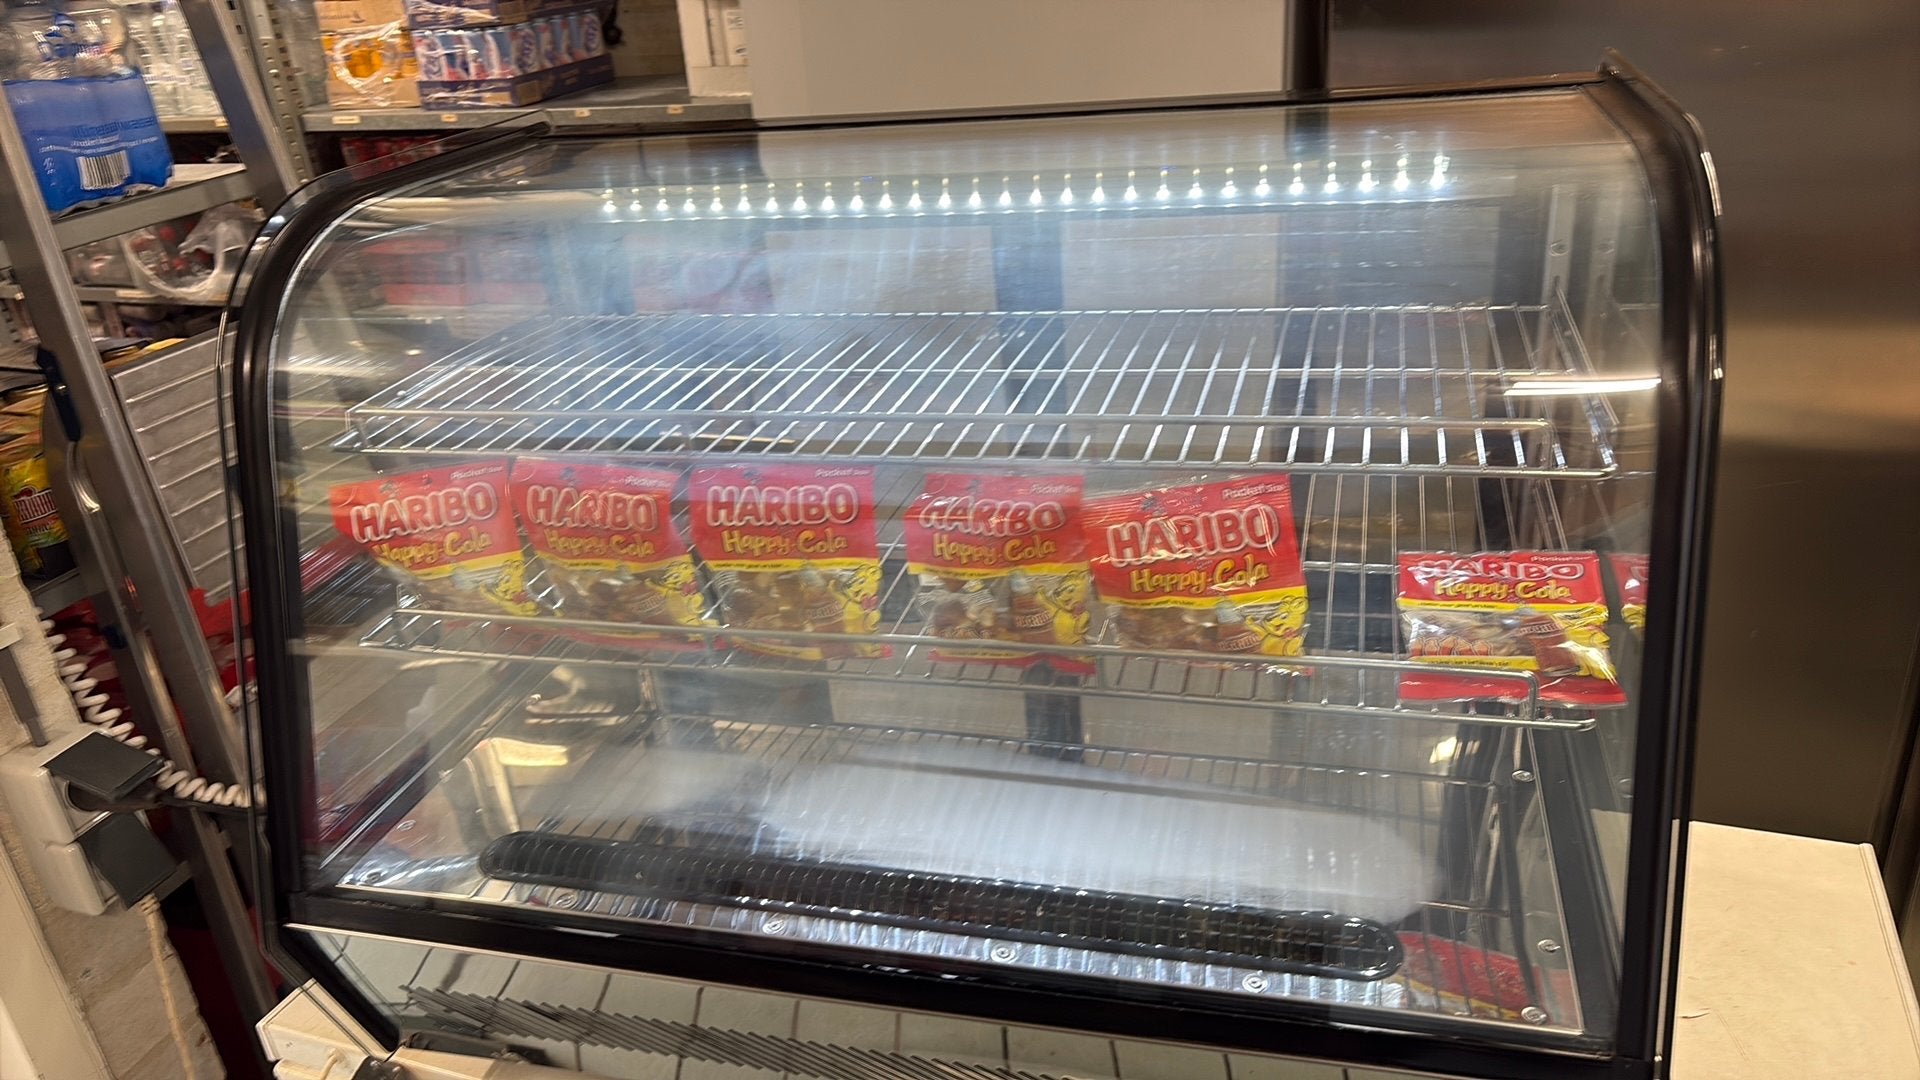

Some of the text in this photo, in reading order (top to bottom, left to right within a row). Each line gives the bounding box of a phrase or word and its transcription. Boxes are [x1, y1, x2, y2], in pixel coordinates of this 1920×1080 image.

[350, 481, 498, 544] HARIBO
[527, 485, 657, 531] HARIBO
[706, 483, 860, 527] HARIBO
[918, 495, 1066, 538] HARIBO
[1106, 503, 1280, 568] HARIBO
